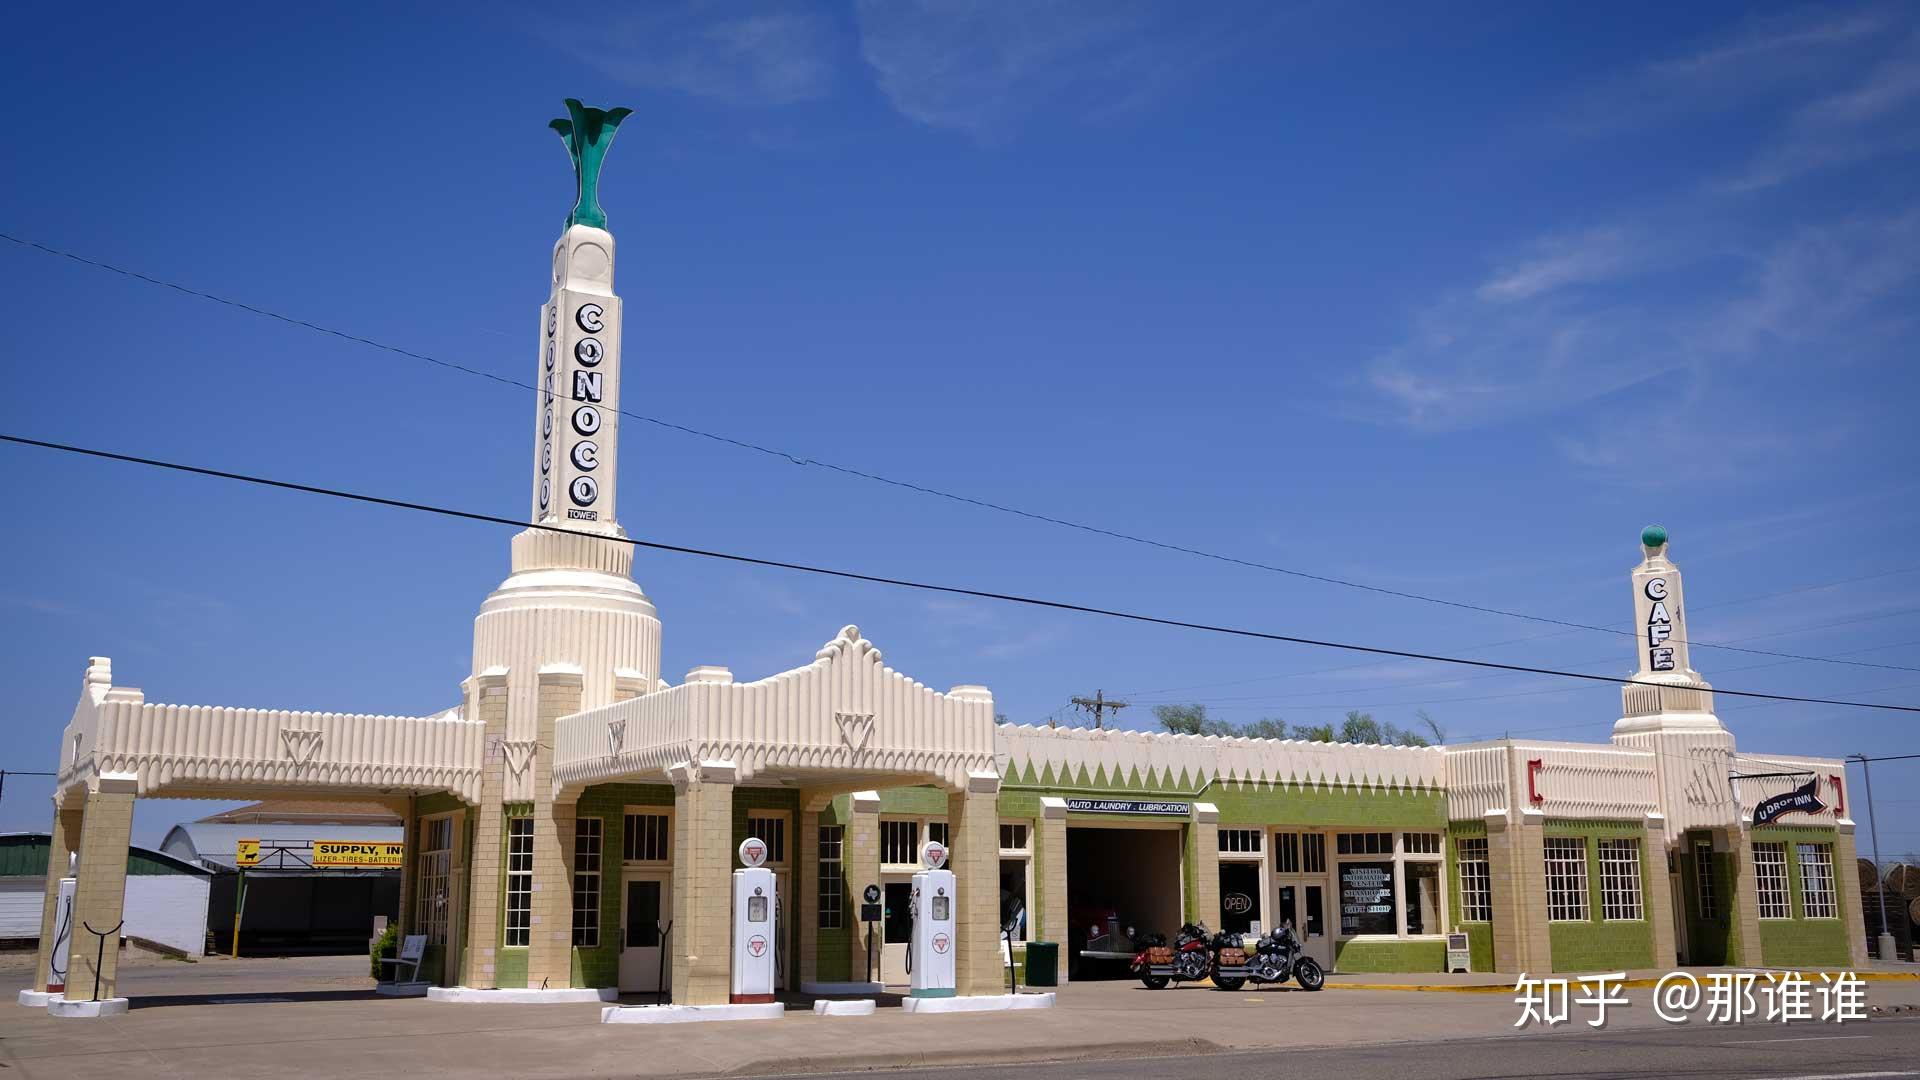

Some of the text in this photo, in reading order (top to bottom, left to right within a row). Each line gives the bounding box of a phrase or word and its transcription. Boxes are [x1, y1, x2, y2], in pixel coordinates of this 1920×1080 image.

[568, 303, 604, 507] CONOCO
[568, 510, 597, 520] TOWER
[1645, 578, 1674, 671] CAFE
[1069, 801, 1187, 813] AUTO LAUNDRY LUBRICATION
[1759, 810, 1767, 820] U
[1794, 794, 1812, 806] INN
[320, 845, 379, 856] SUPPLY,
[1225, 898, 1247, 910] OPEN
